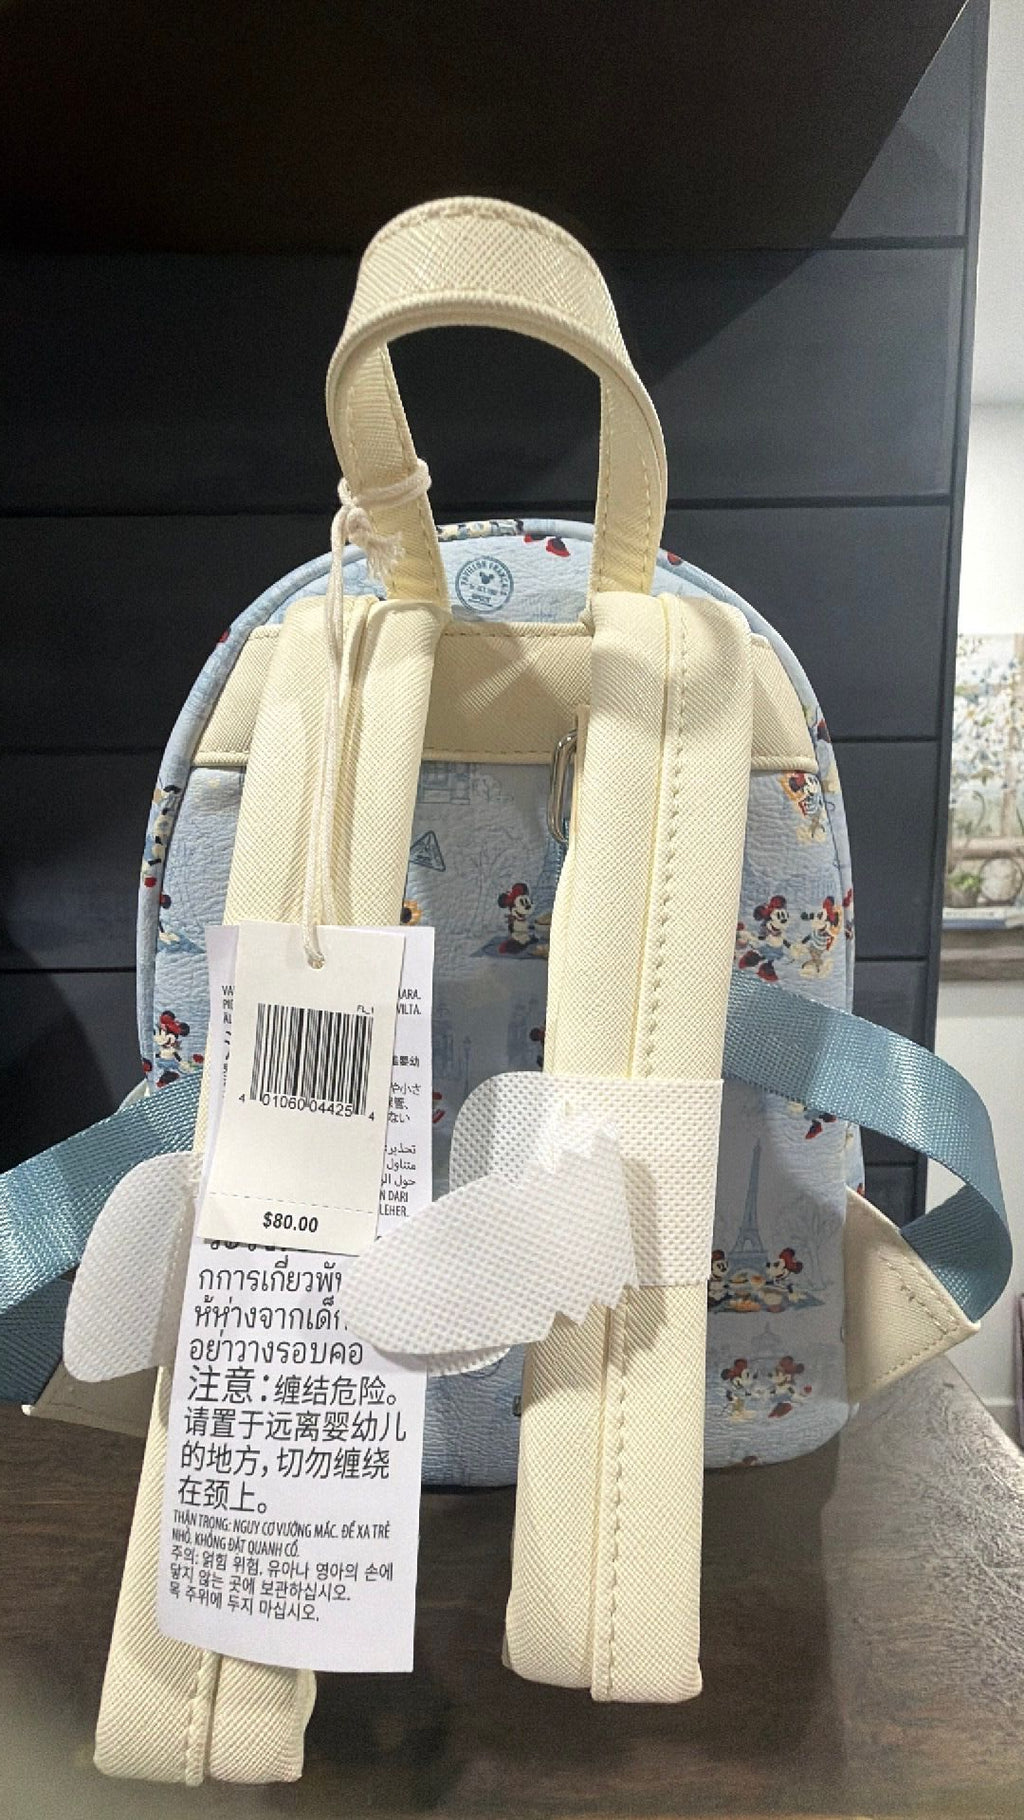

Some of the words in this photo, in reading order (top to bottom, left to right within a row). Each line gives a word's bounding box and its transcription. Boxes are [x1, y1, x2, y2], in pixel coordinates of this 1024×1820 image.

[239, 1093, 246, 1104] 4
[368, 1111, 375, 1121] 4
[388, 1190, 409, 1203] DARI
[262, 1211, 319, 1233] $80.00
[184, 1406, 407, 1443] 请置于远离婴幼儿
[178, 1475, 268, 1514] 在颈上。
[233, 1518, 260, 1535] NGUY
[356, 1524, 371, 1539] XA
[247, 1539, 283, 1558] QUANH
[267, 1559, 310, 1580] 유아나
[315, 1561, 359, 1582] 영아의
[364, 1561, 394, 1582] 손에
[228, 1575, 256, 1596] 곳에
[260, 1579, 351, 1603] 보관하십시오.
[227, 1594, 254, 1616] 두지
[259, 1598, 320, 1622] 마십시오.
